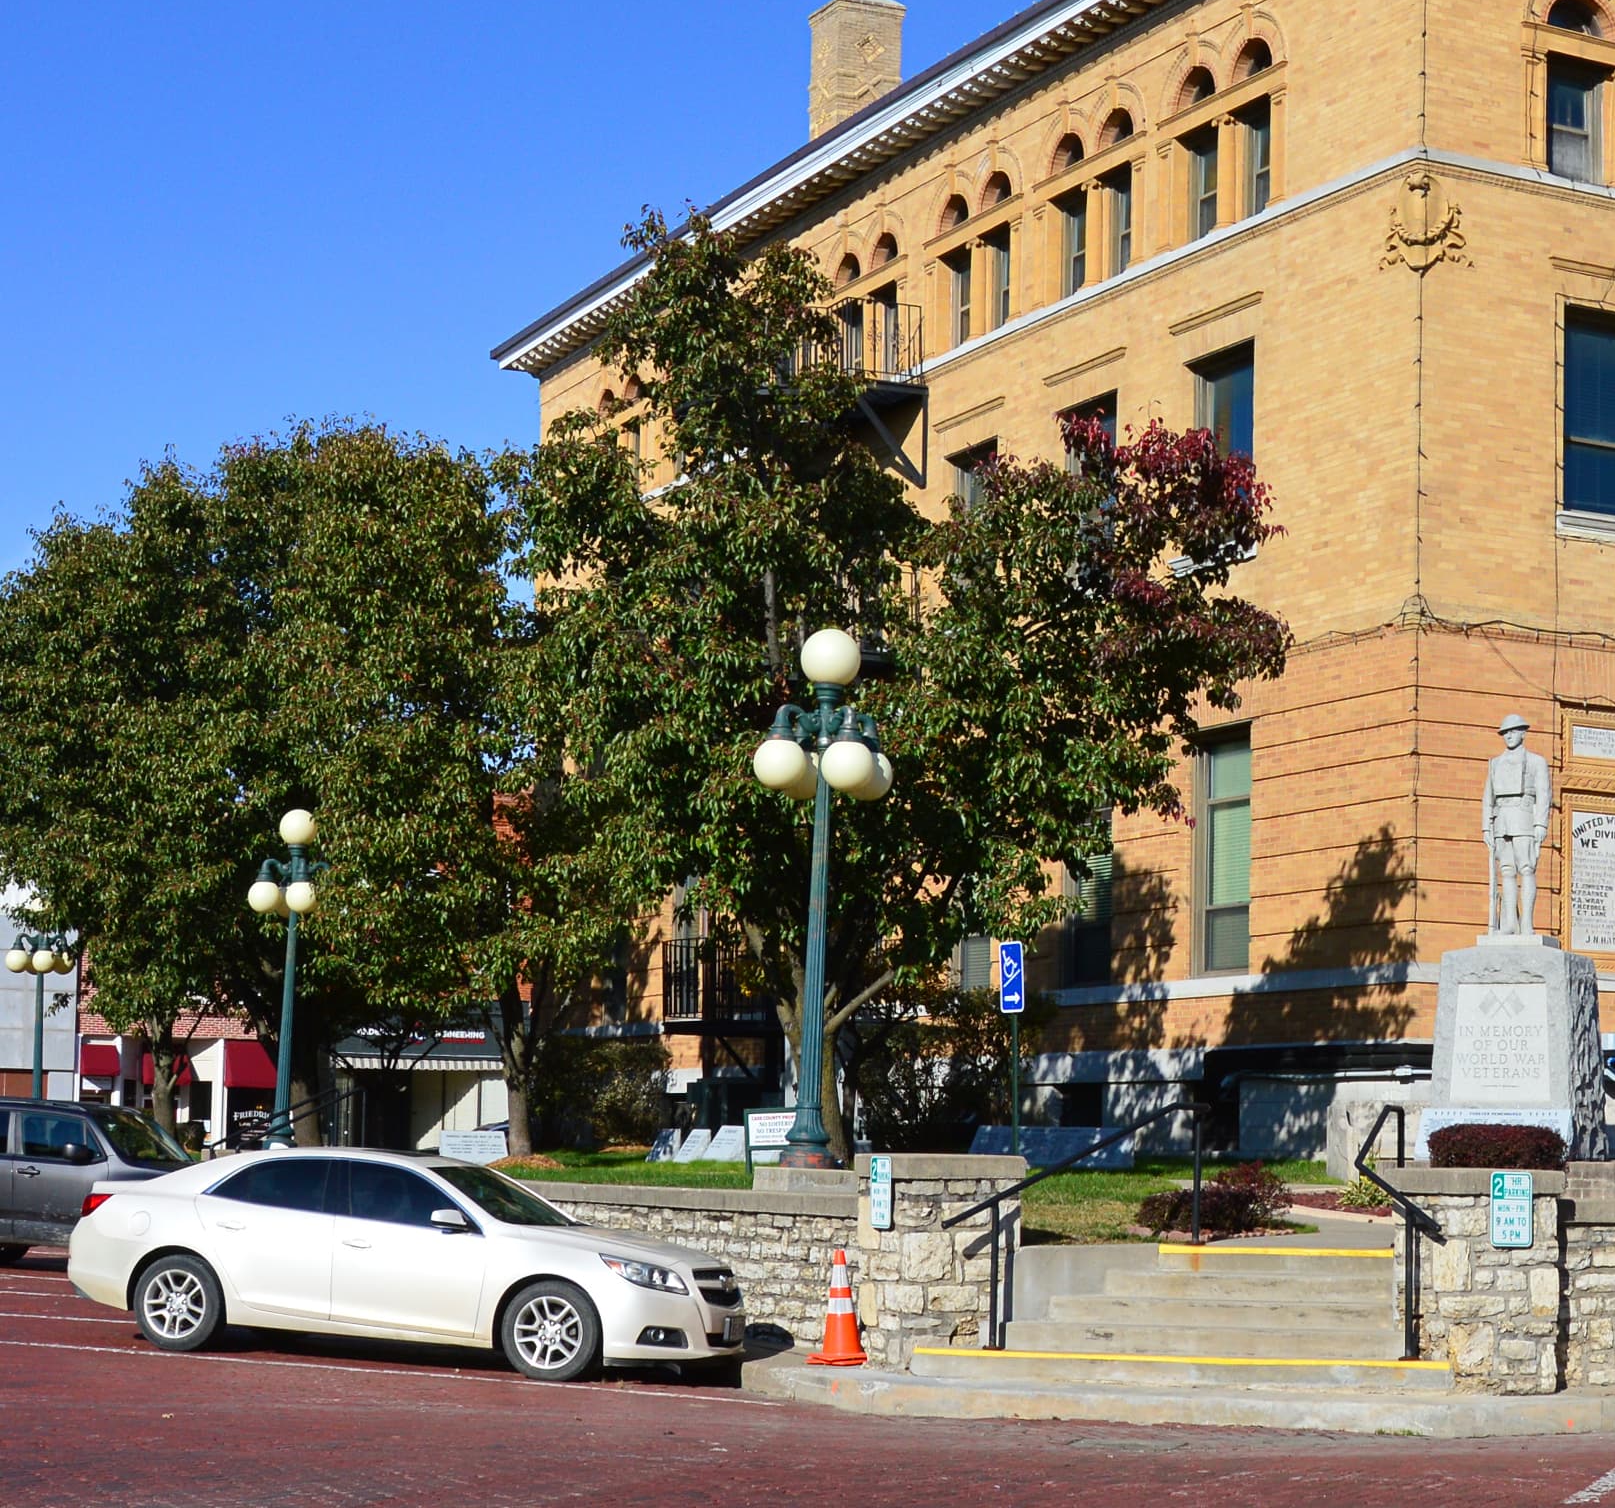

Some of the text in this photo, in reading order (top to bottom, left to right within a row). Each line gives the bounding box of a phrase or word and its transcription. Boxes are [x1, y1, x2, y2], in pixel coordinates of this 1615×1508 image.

[1572, 817, 1604, 839] UNITED
[1580, 838, 1599, 849] WE
[1459, 1025, 1544, 1038] IN MEMORY
[1472, 1039, 1529, 1051] OF OUR
[1456, 1053, 1546, 1065] WORLD WAR
[1462, 1067, 1541, 1079] VETERANS
[872, 1161, 877, 1180] 2
[1494, 1177, 1503, 1197] 2
[1511, 1176, 1522, 1186] HR
[1504, 1188, 1529, 1197] PARKING
[1496, 1216, 1527, 1227] 9 AM TO
[1502, 1229, 1521, 1240] 5 PM
